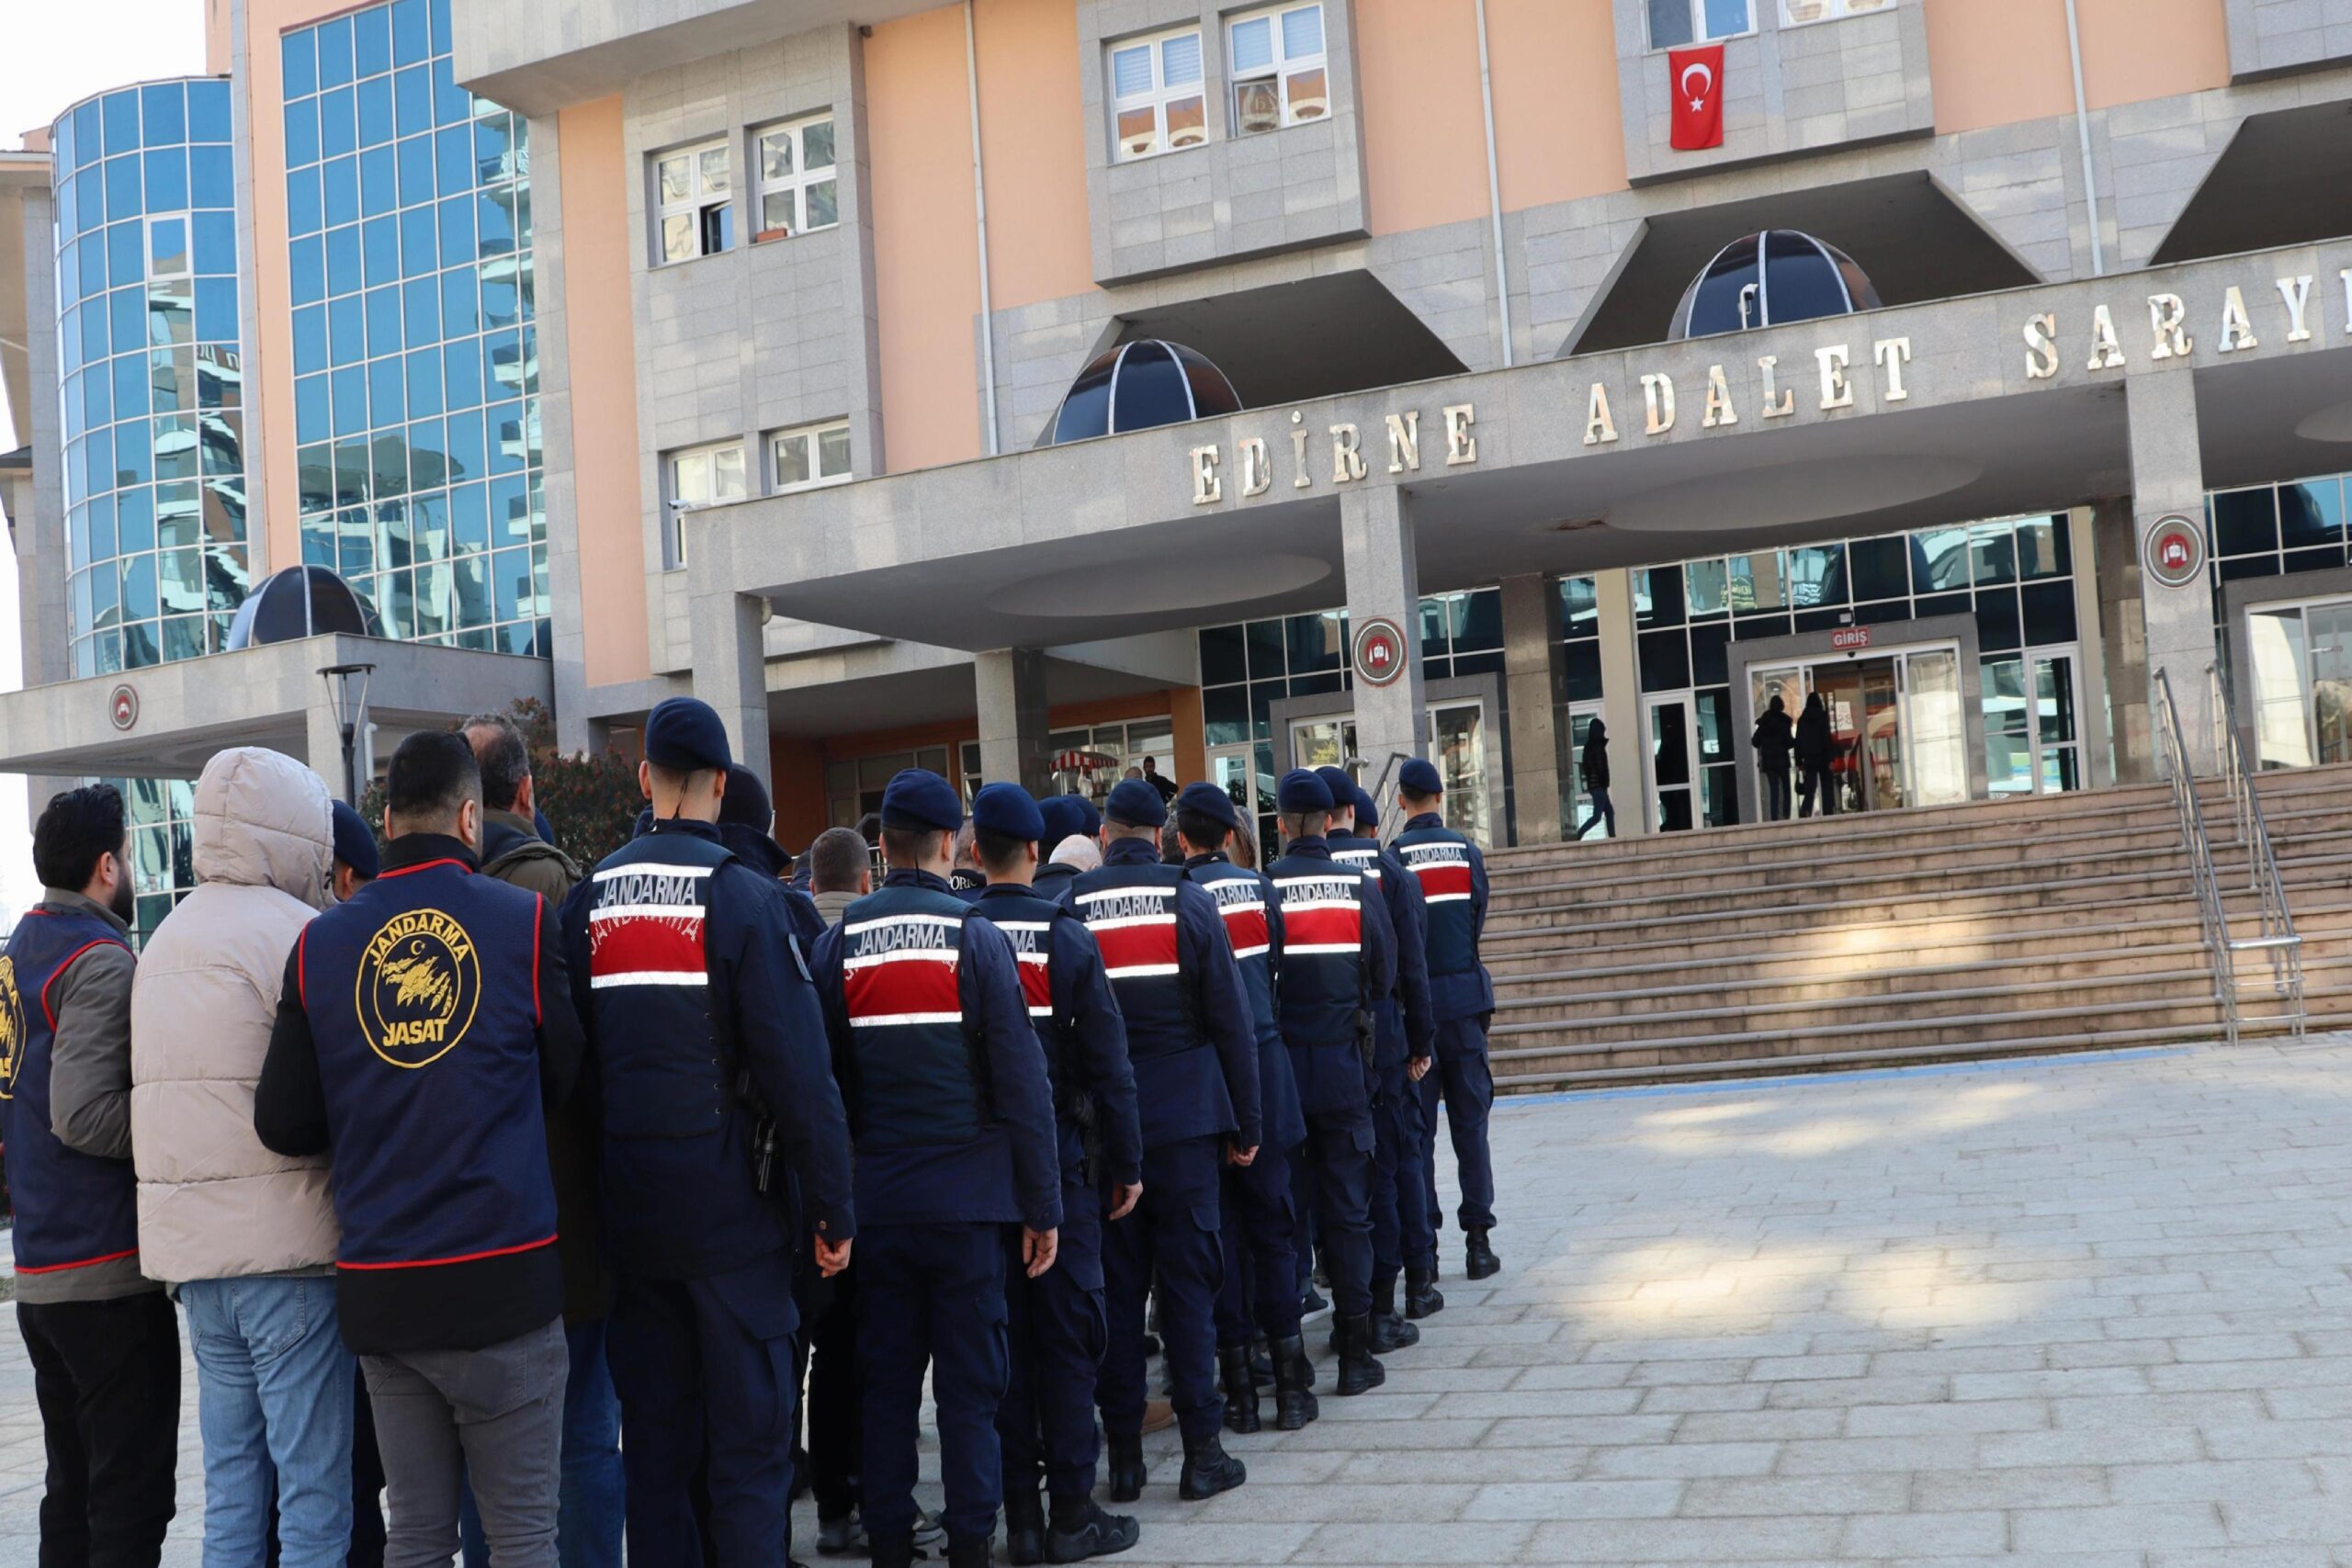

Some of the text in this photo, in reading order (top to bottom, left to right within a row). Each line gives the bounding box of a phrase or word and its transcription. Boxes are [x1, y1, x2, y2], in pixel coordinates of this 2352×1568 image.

[1189, 403, 1477, 504] EDİRNE
[1583, 336, 1911, 446] ADALET
[1834, 629, 1868, 647] GİRİŞ
[1408, 847, 1463, 866] JANDARMA
[597, 874, 696, 908] JANDARMA
[1283, 882, 1352, 904] JANDARMA
[1085, 895, 1165, 921] JANDARMA
[369, 913, 470, 966] JANDARMA
[854, 924, 947, 957] JANDARMA
[382, 1018, 449, 1047] JASAT
